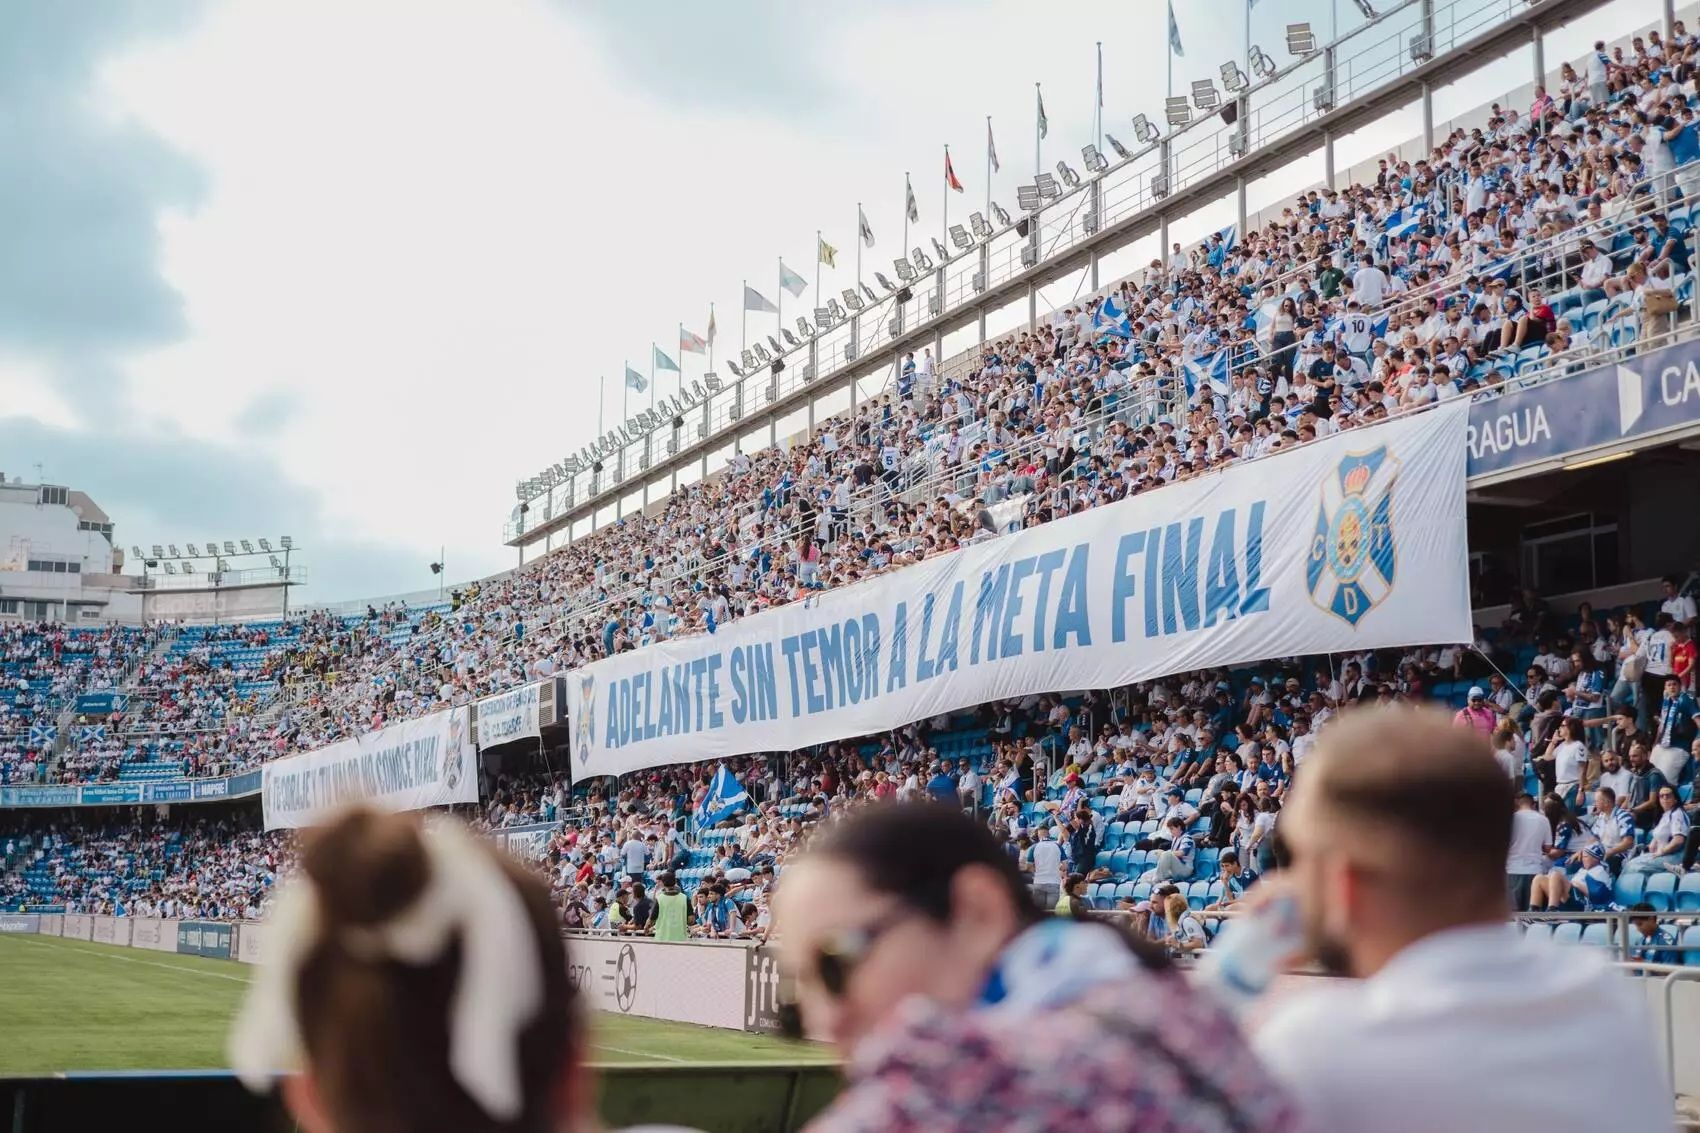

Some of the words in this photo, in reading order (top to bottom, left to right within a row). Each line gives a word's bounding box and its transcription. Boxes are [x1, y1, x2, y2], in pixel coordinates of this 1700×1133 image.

[1351, 319, 1365, 334] 10
[1343, 587, 1358, 616] D
[605, 653, 724, 749] ADELANTE
[730, 642, 778, 724] SIN
[781, 612, 881, 718] TEMOR
[886, 601, 907, 693] A
[916, 580, 965, 682] LA
[969, 542, 1092, 665] META
[1111, 500, 1271, 643] FINAL
